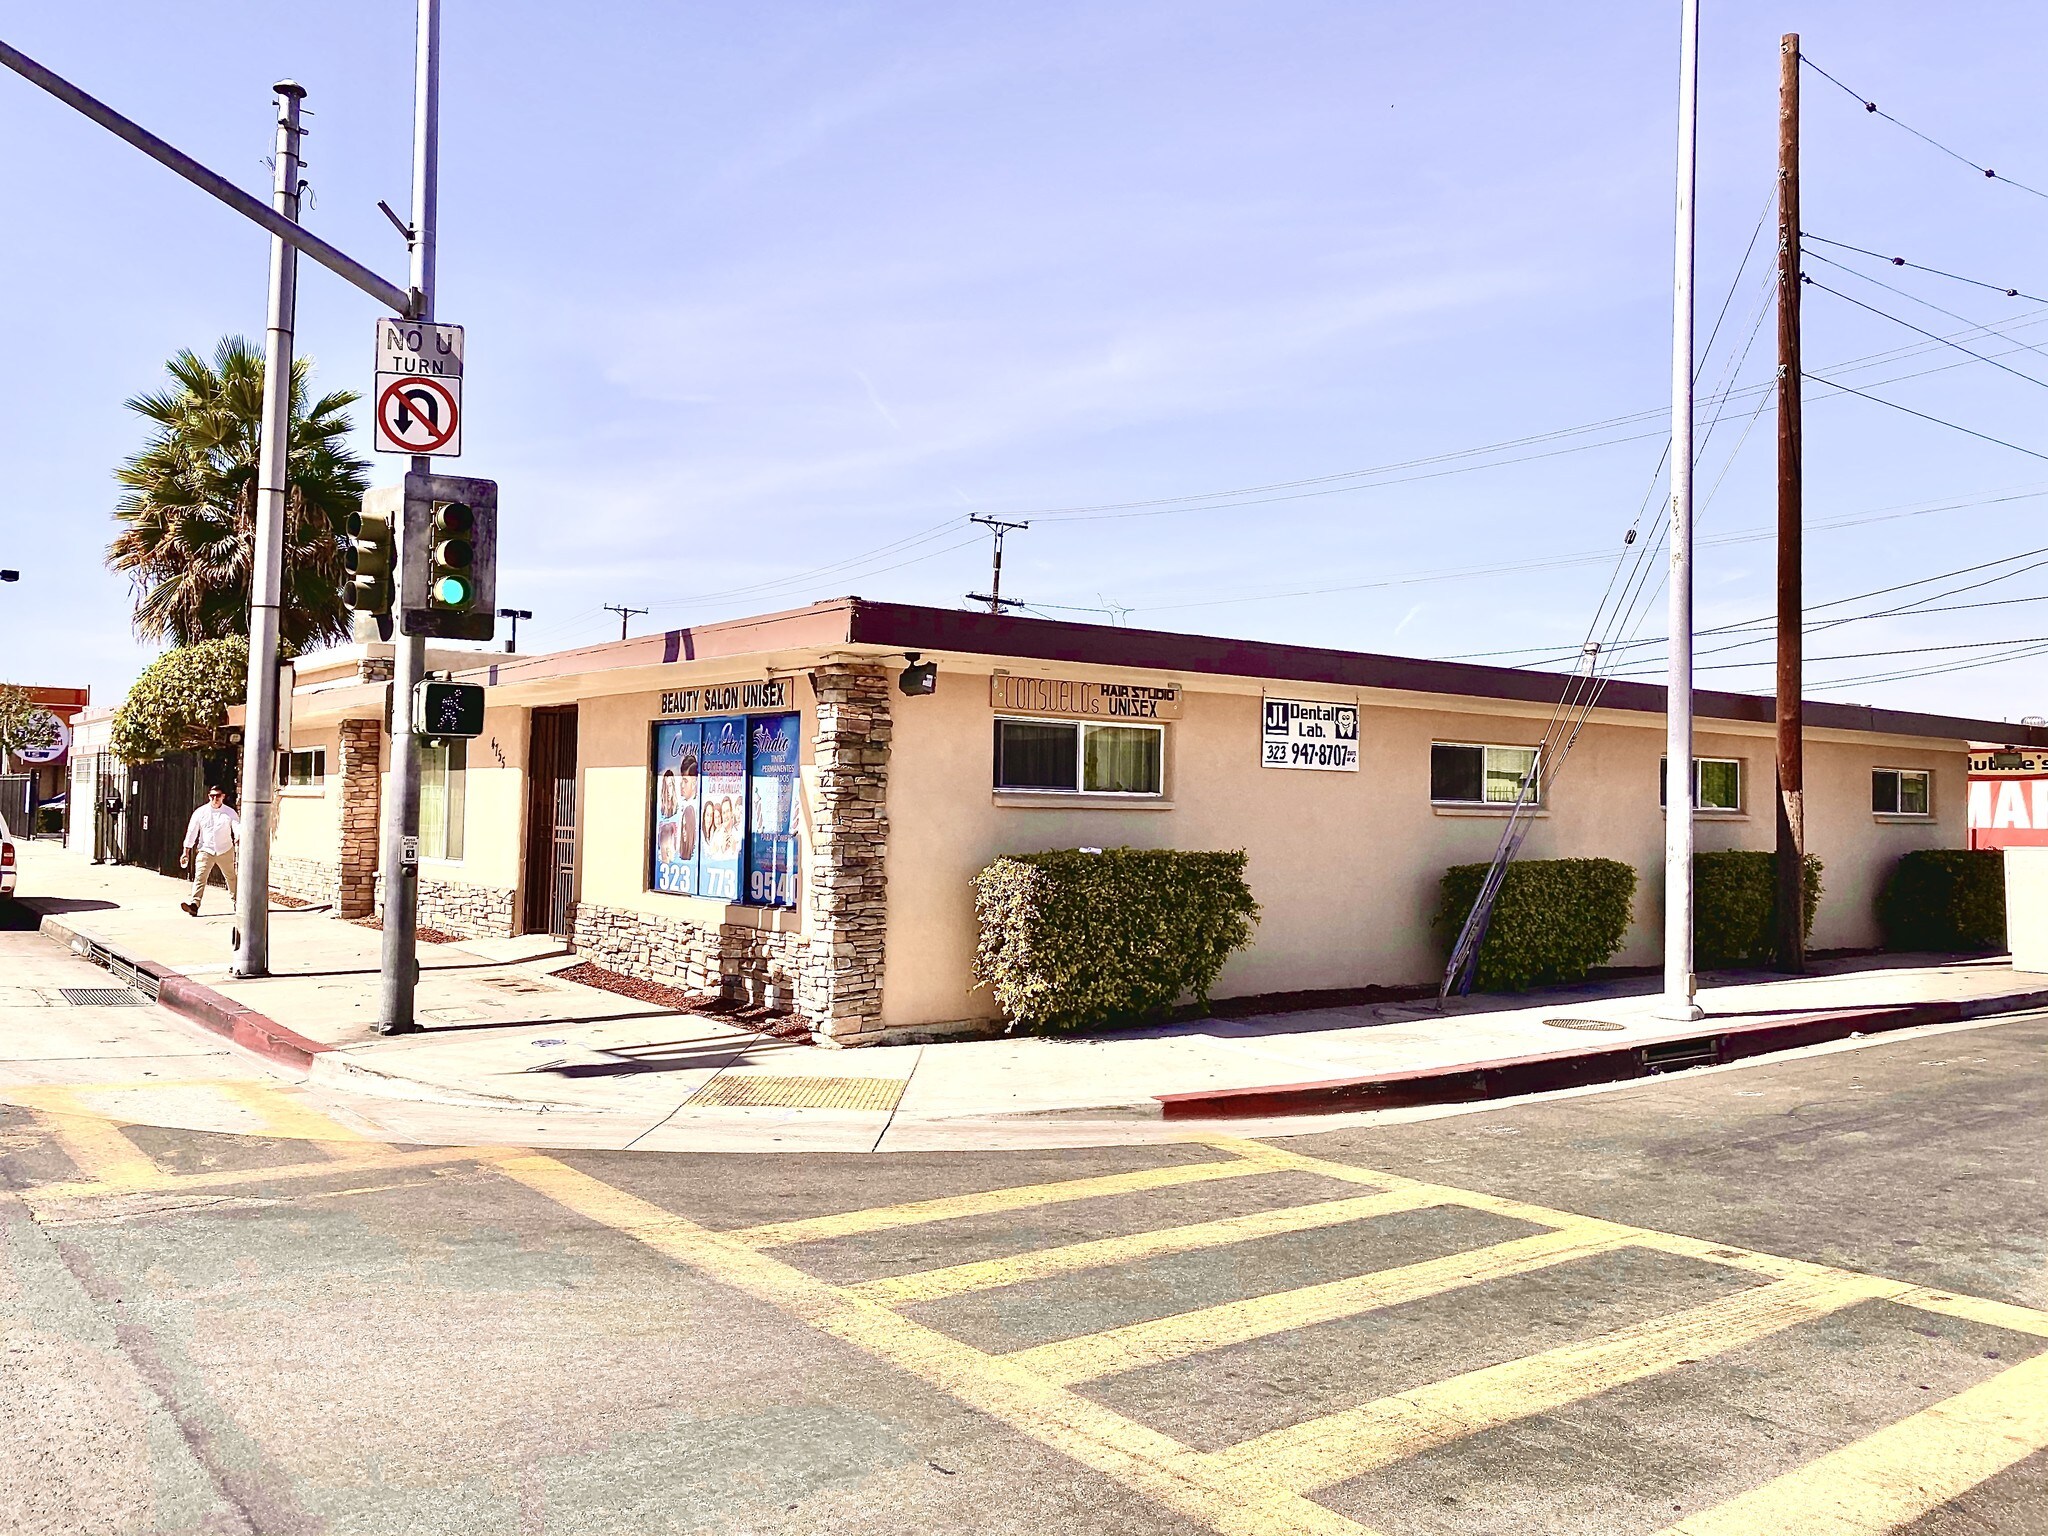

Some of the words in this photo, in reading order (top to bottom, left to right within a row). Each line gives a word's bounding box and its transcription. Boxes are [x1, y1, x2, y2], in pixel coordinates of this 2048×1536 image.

[387, 328, 423, 352] NO
[435, 332, 453, 355] U
[393, 356, 444, 374] TURN
[661, 690, 700, 714] BEAUTY
[704, 686, 740, 712] SALON
[743, 682, 786, 709] UNISEX
[1100, 684, 1130, 698] HAIR
[1133, 686, 1175, 701] STUDIO
[1108, 697, 1158, 718] UNISEX
[1267, 704, 1288, 728] JL
[1290, 703, 1335, 722] Dental
[1299, 721, 1326, 738] Lab.
[1267, 744, 1287, 760] 323
[660, 863, 691, 893] 323
[706, 867, 736, 899] 773
